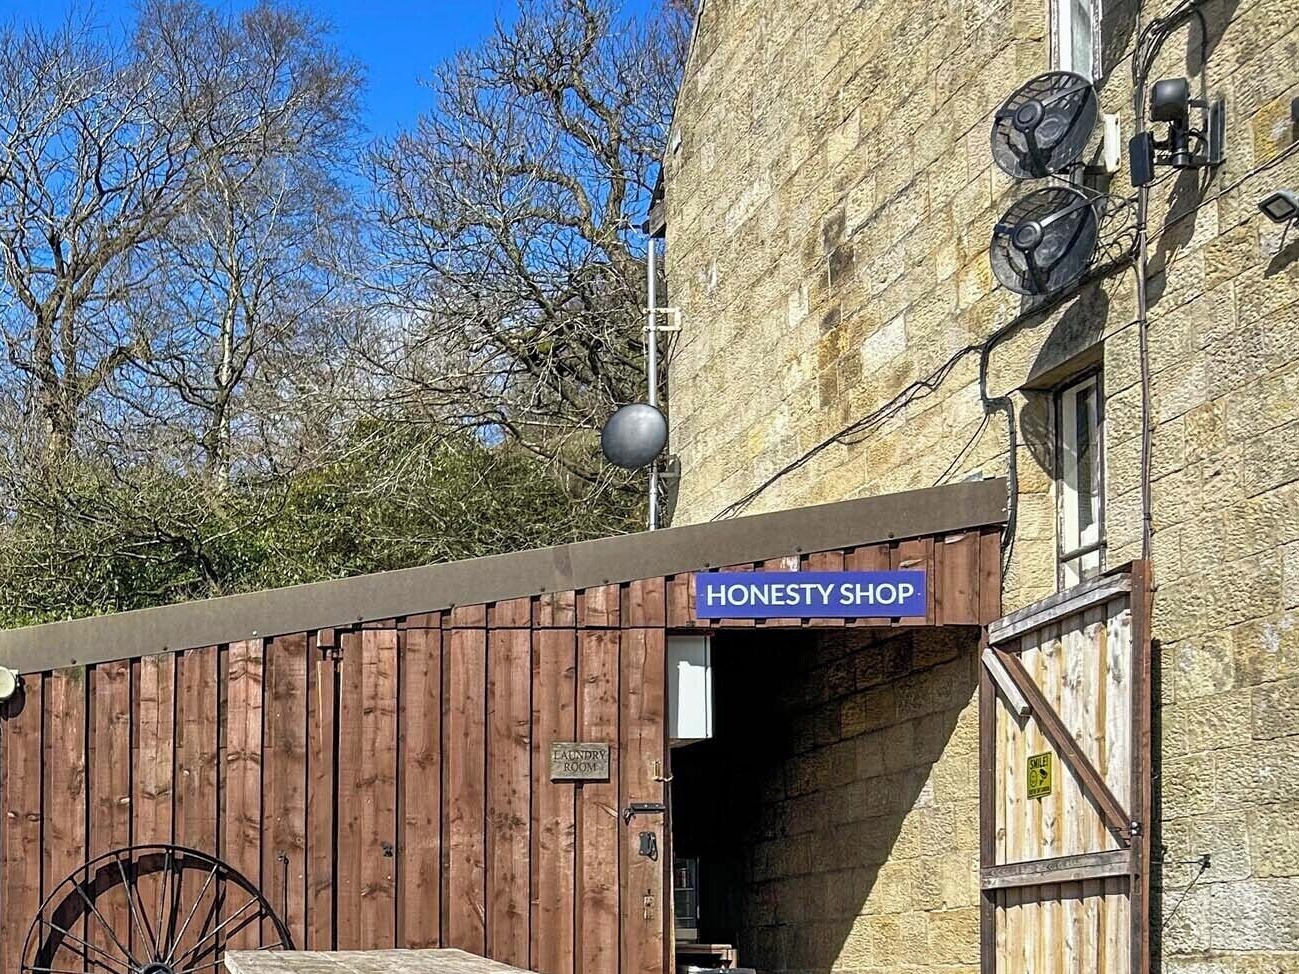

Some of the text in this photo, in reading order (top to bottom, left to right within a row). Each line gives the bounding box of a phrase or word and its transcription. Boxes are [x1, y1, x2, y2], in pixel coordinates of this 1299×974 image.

[707, 583, 914, 606] HONESTY SHOP
[553, 749, 607, 761] LAUNDRY
[564, 762, 597, 772] ROOM
